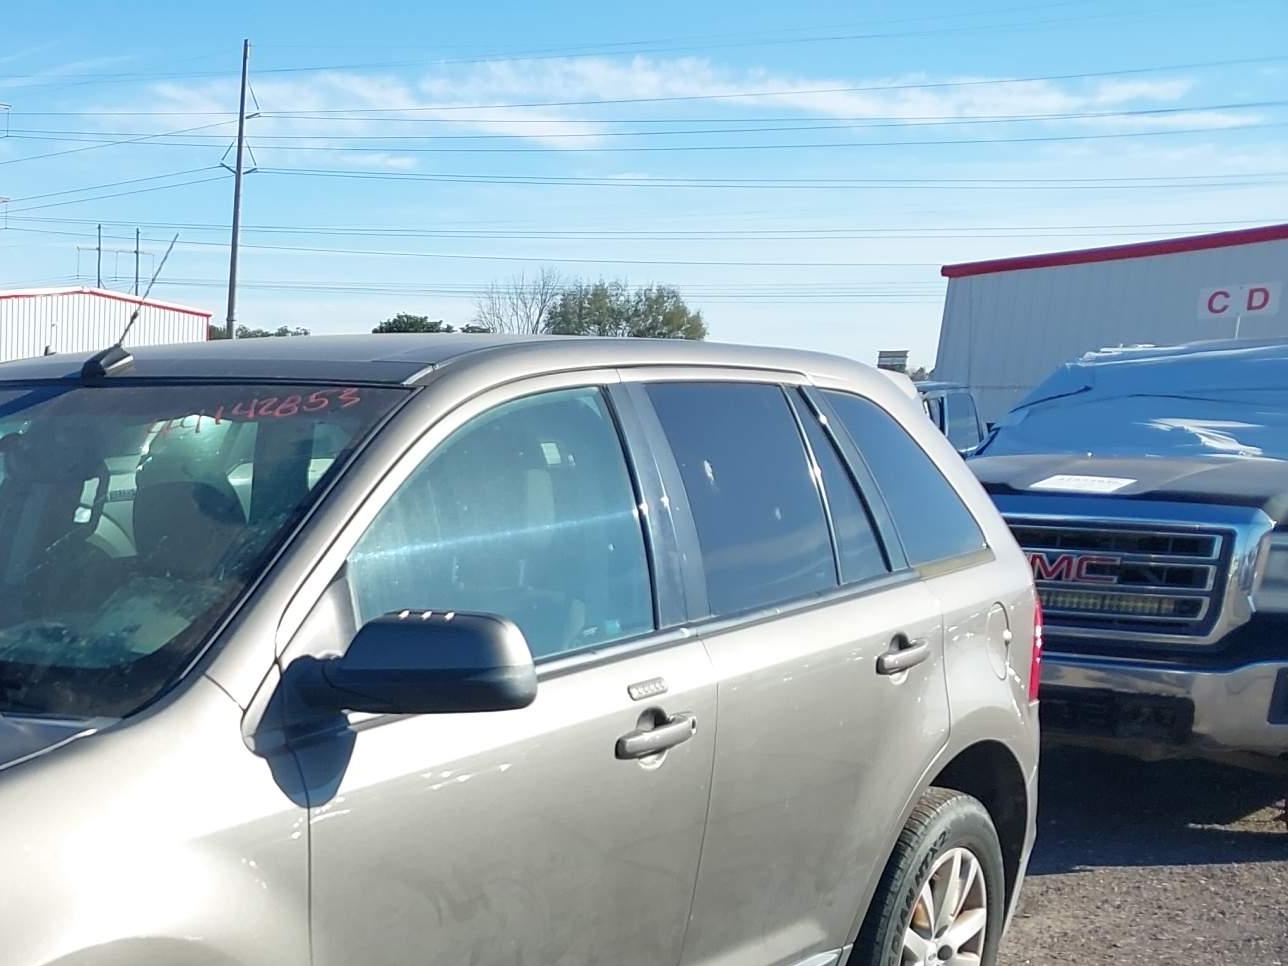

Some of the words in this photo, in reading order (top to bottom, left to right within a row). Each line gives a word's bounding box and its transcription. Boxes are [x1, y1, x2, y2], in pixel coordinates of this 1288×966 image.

[1208, 291, 1230, 313] C
[1247, 288, 1270, 310] D
[1026, 552, 1121, 584] MC
